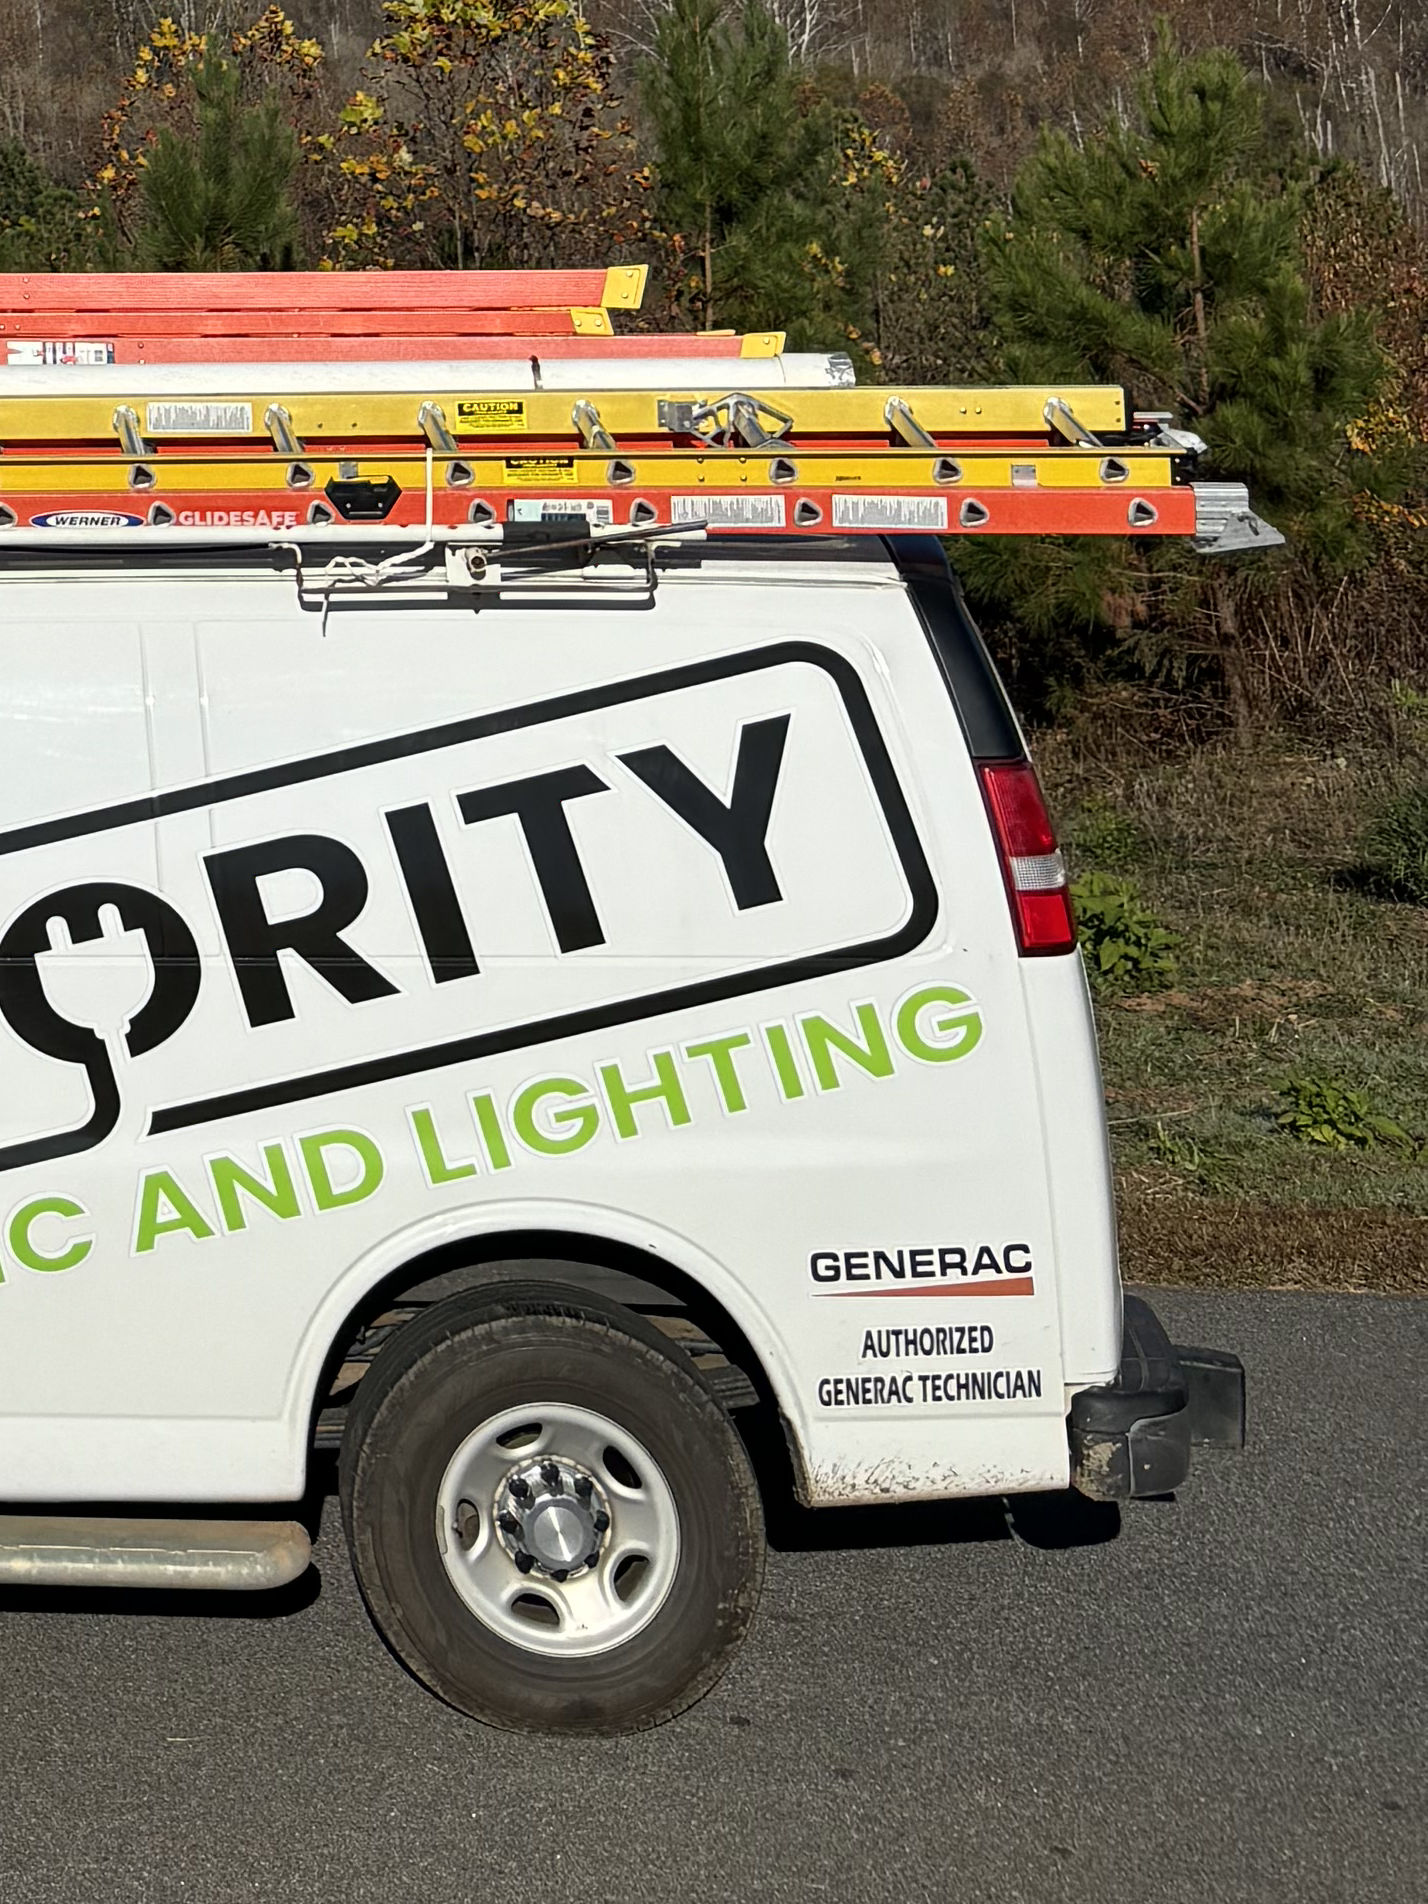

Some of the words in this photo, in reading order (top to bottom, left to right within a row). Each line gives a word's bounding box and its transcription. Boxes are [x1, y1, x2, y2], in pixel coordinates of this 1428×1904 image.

[462, 402, 519, 413] CAUTION
[54, 515, 122, 527] WERNER
[178, 510, 298, 527] GLIDESAFE
[134, 1128, 386, 1254] AND
[411, 986, 984, 1186] LIGHTING
[809, 1243, 1033, 1283] GENERAC
[861, 1325, 994, 1359] AUTHORIZED
[818, 1375, 914, 1407] GENERAC
[919, 1369, 1042, 1403] TECHNICIAN
